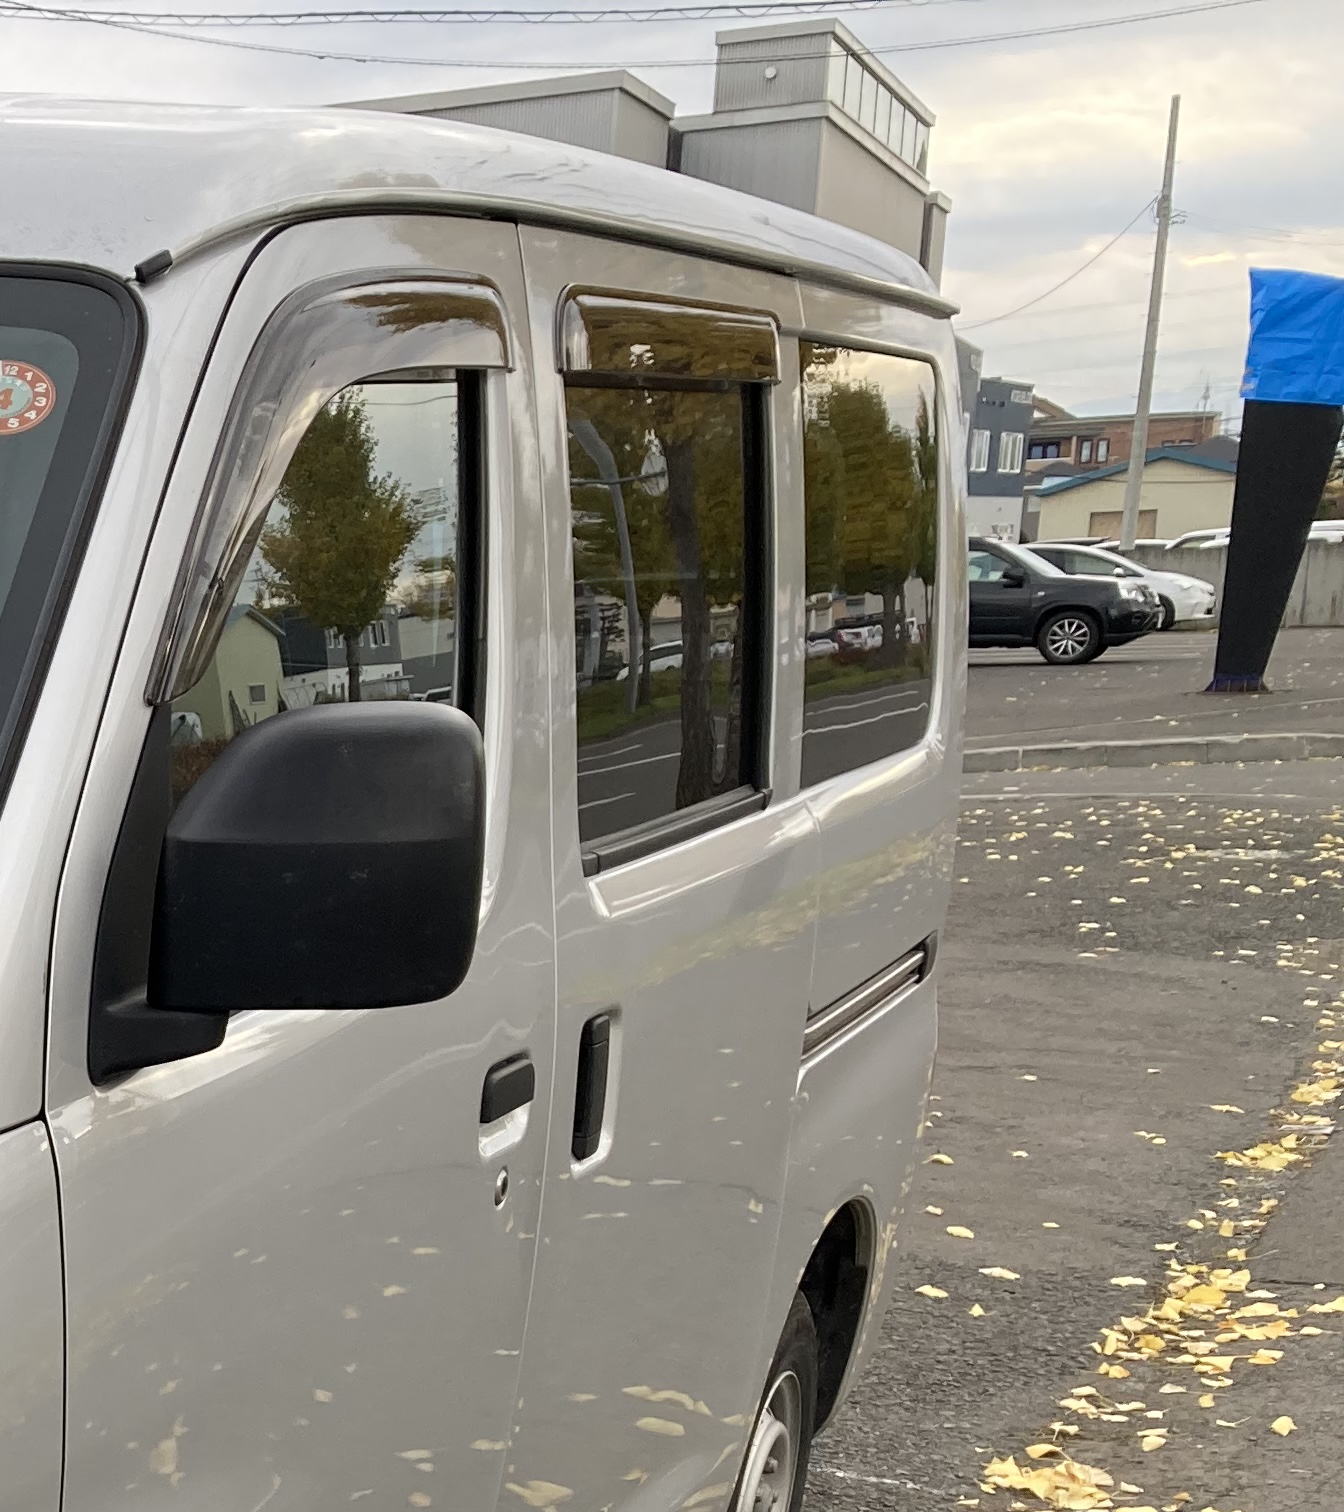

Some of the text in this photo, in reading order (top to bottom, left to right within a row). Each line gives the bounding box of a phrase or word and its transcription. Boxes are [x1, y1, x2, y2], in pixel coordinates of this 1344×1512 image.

[4, 365, 19, 376] 12
[24, 371, 33, 381] 1
[33, 382, 47, 393] 2
[34, 396, 47, 407] 3
[24, 410, 37, 420] 4
[7, 418, 20, 428] 5
